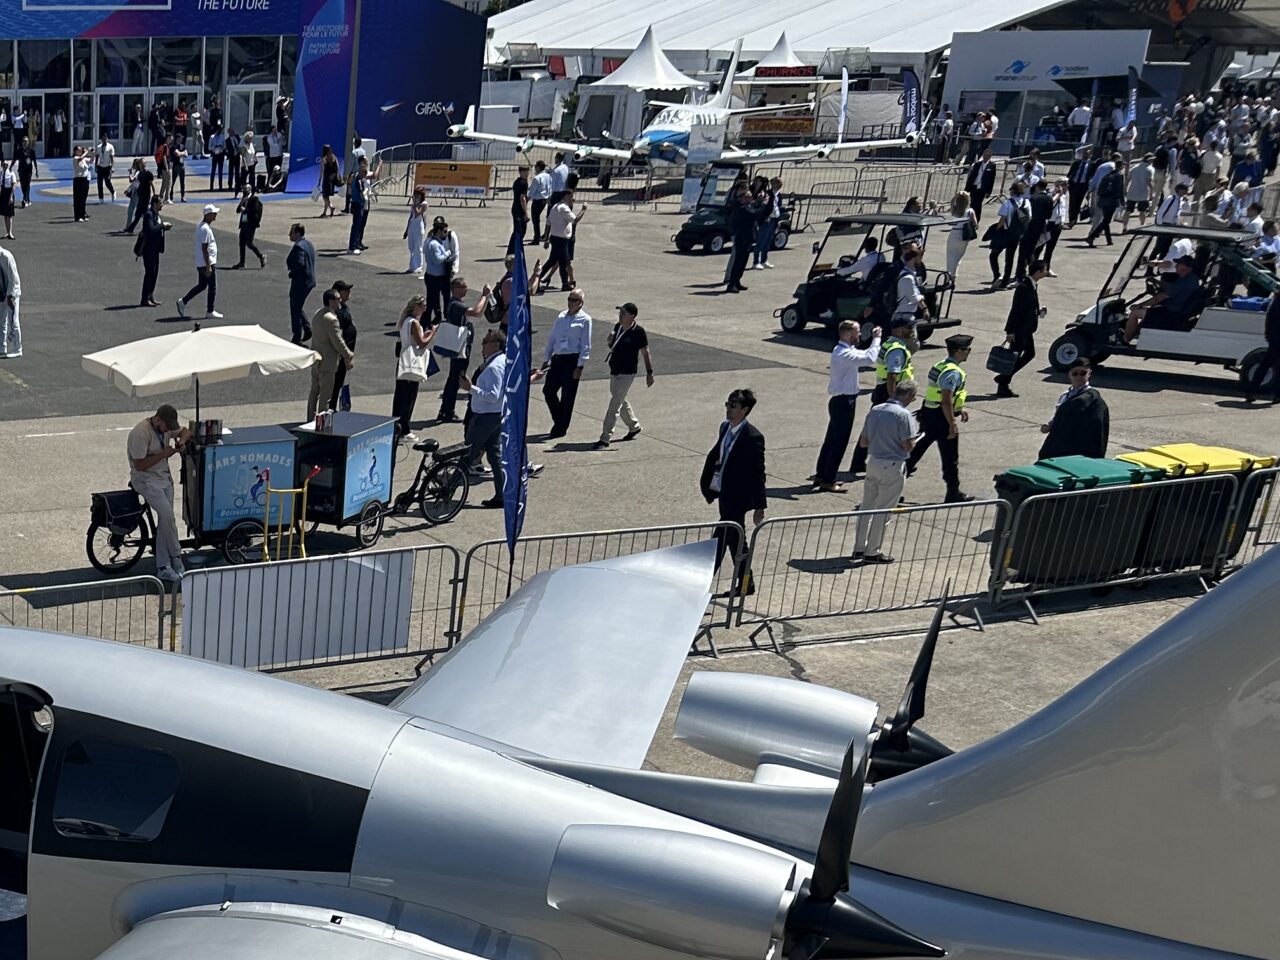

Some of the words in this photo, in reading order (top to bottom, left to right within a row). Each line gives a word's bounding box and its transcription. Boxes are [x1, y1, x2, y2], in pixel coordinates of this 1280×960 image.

[198, 0, 219, 10] THE
[222, 0, 270, 10] FUTURE
[415, 102, 443, 116] GIFAS
[239, 452, 293, 468] NOMADES
